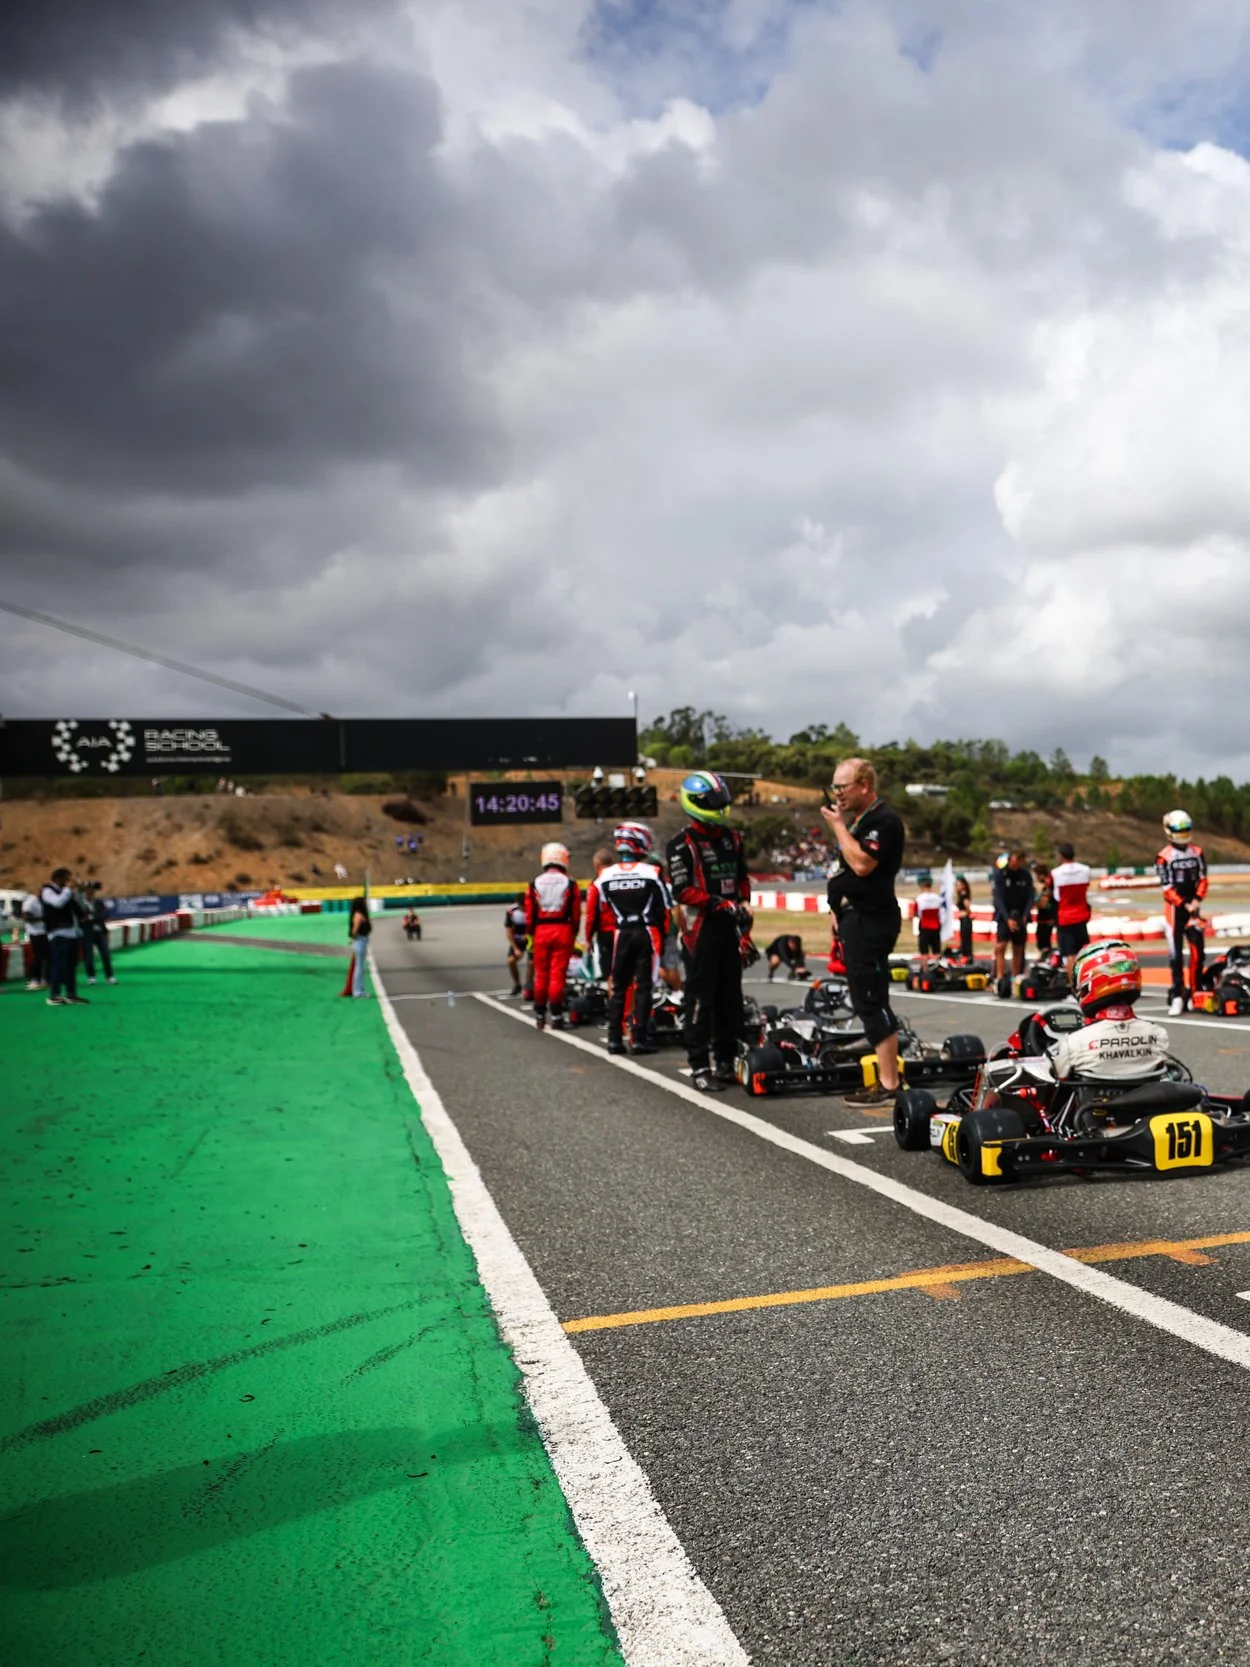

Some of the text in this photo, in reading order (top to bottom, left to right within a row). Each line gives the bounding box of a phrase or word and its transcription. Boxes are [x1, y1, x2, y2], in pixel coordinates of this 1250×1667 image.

[143, 729, 219, 741] RACING
[144, 741, 232, 752] SCHOOL
[475, 793, 560, 813] 14:20:45
[608, 880, 646, 891] SODI
[1100, 1035, 1158, 1047] PAROLIN
[1099, 1047, 1152, 1061] KHAVALKIN
[1165, 1119, 1203, 1161] 151
